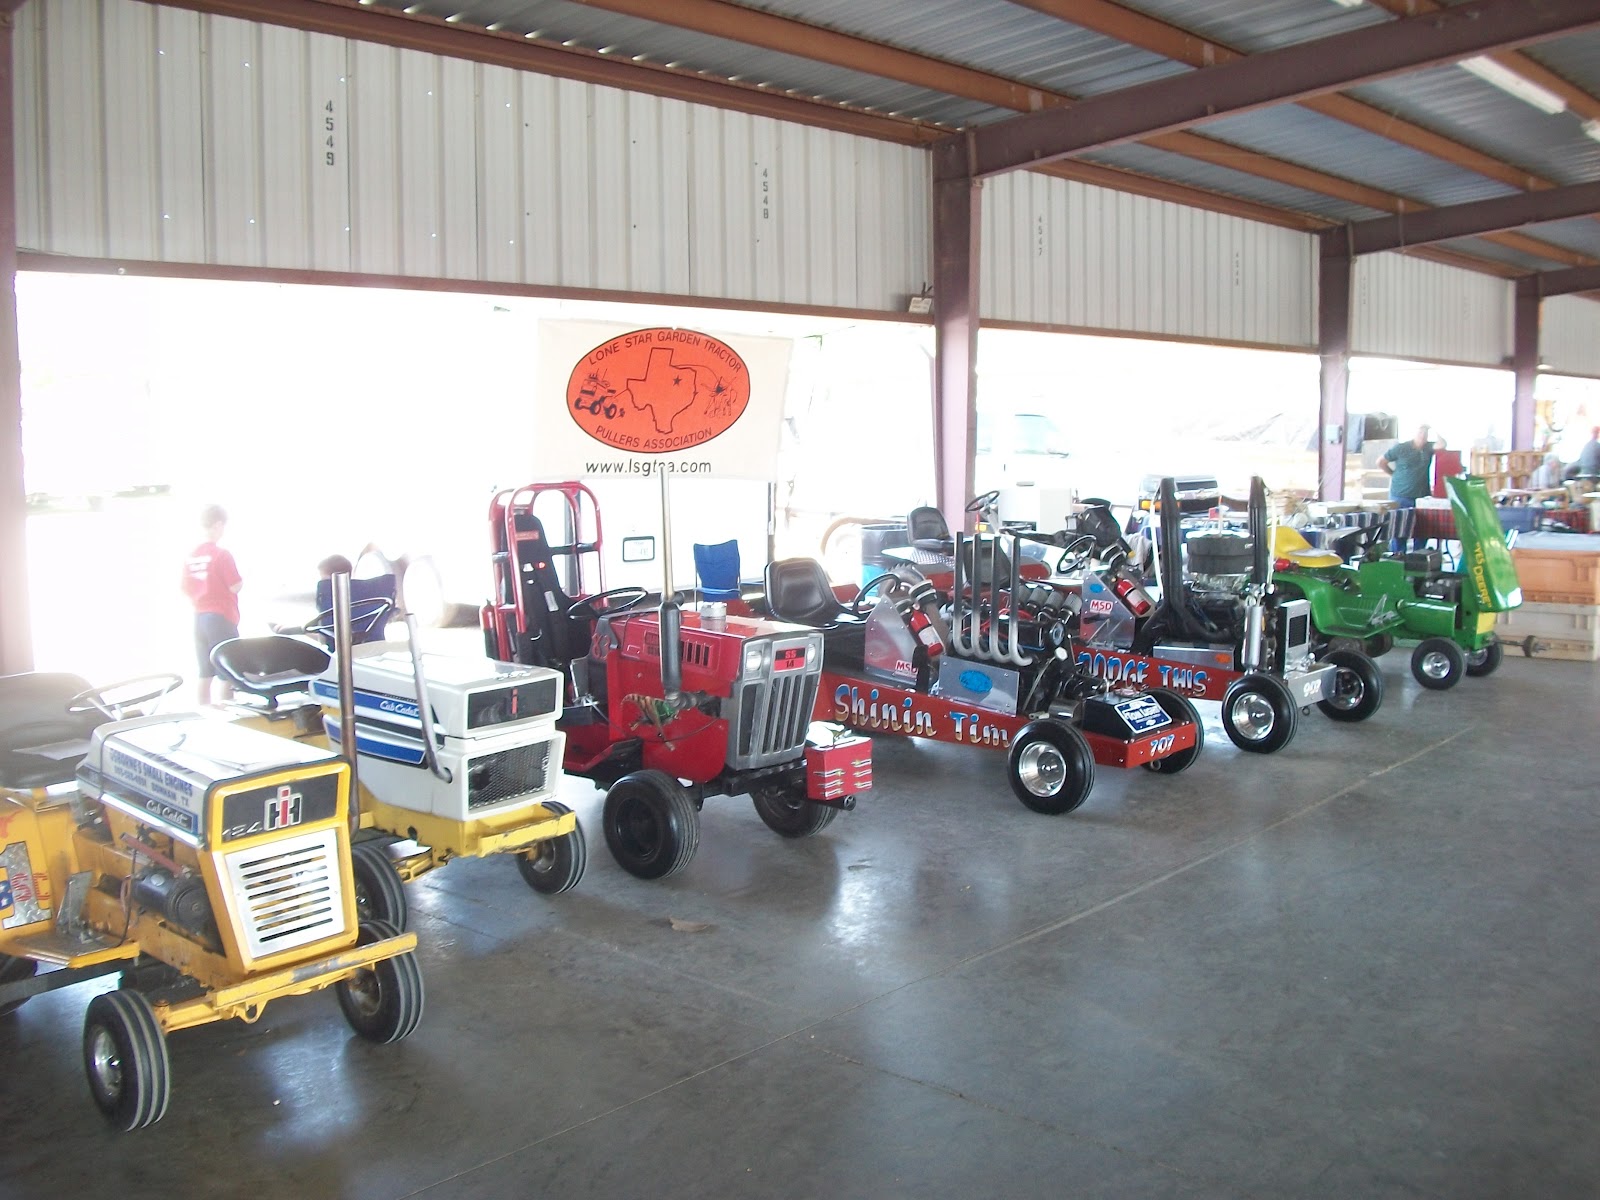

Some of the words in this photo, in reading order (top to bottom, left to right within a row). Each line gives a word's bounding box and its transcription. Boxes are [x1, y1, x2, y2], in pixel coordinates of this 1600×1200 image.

[325, 99, 335, 166] 4549
[588, 341, 620, 366] LONE
[624, 332, 652, 349] STAR
[657, 330, 701, 347] GARDEN
[703, 339, 742, 374] TRACTOR
[595, 424, 641, 448] PULLERS
[643, 426, 712, 450] ASSOCIATION
[1091, 600, 1112, 611] MSD
[1157, 665, 1208, 697] THIS
[380, 700, 395, 712] Cub
[395, 703, 420, 717] Cadet
[834, 683, 937, 737] Shinin
[1150, 734, 1175, 757] 707
[146, 799, 161, 815] Cub
[162, 806, 188, 826] Cadet
